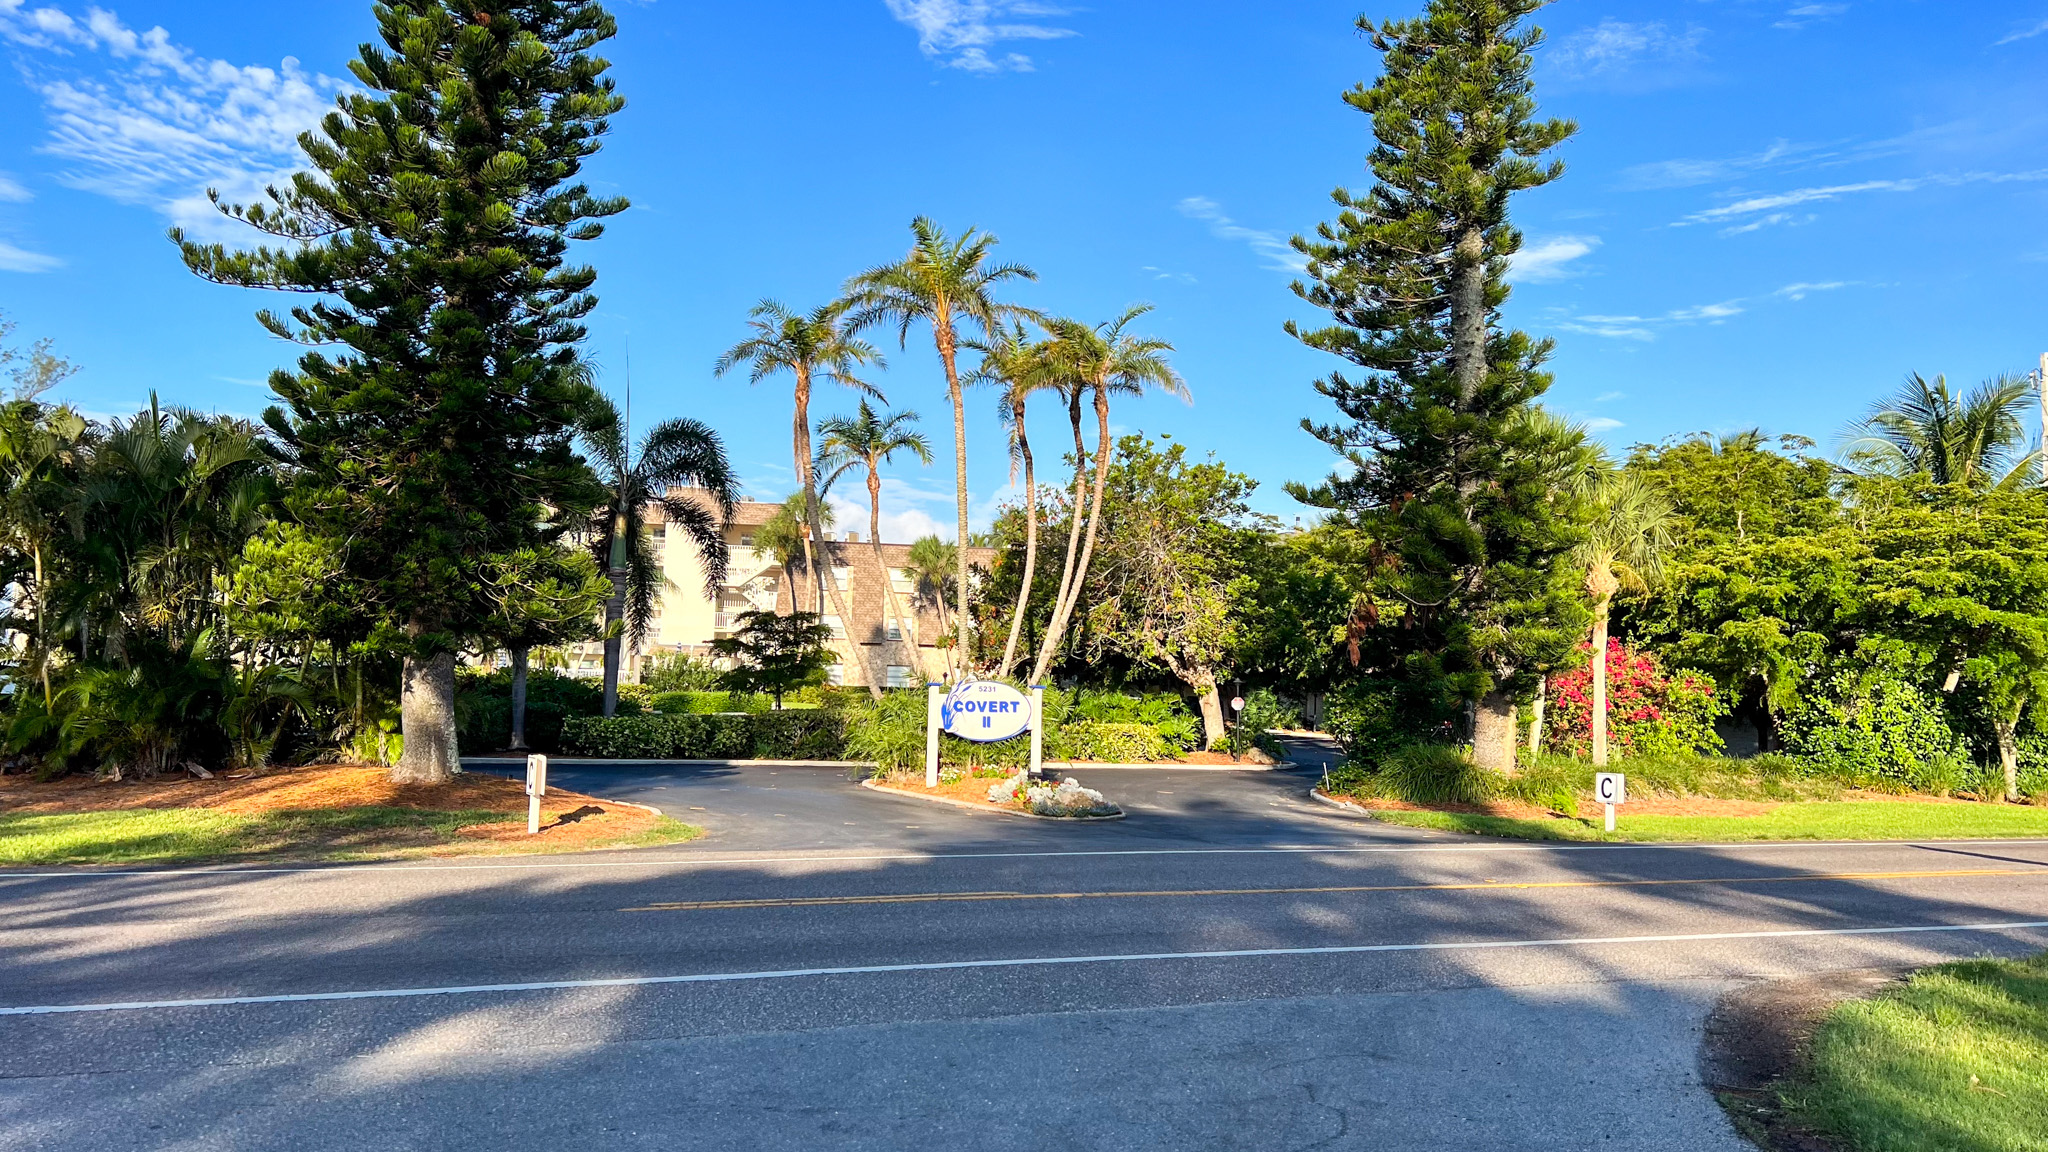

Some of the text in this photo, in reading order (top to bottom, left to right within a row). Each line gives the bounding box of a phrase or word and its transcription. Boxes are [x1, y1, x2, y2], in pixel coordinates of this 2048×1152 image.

[978, 685, 996, 693] 5231
[953, 700, 1020, 713] COVERT
[982, 716, 991, 728] II
[1601, 777, 1612, 798] C
